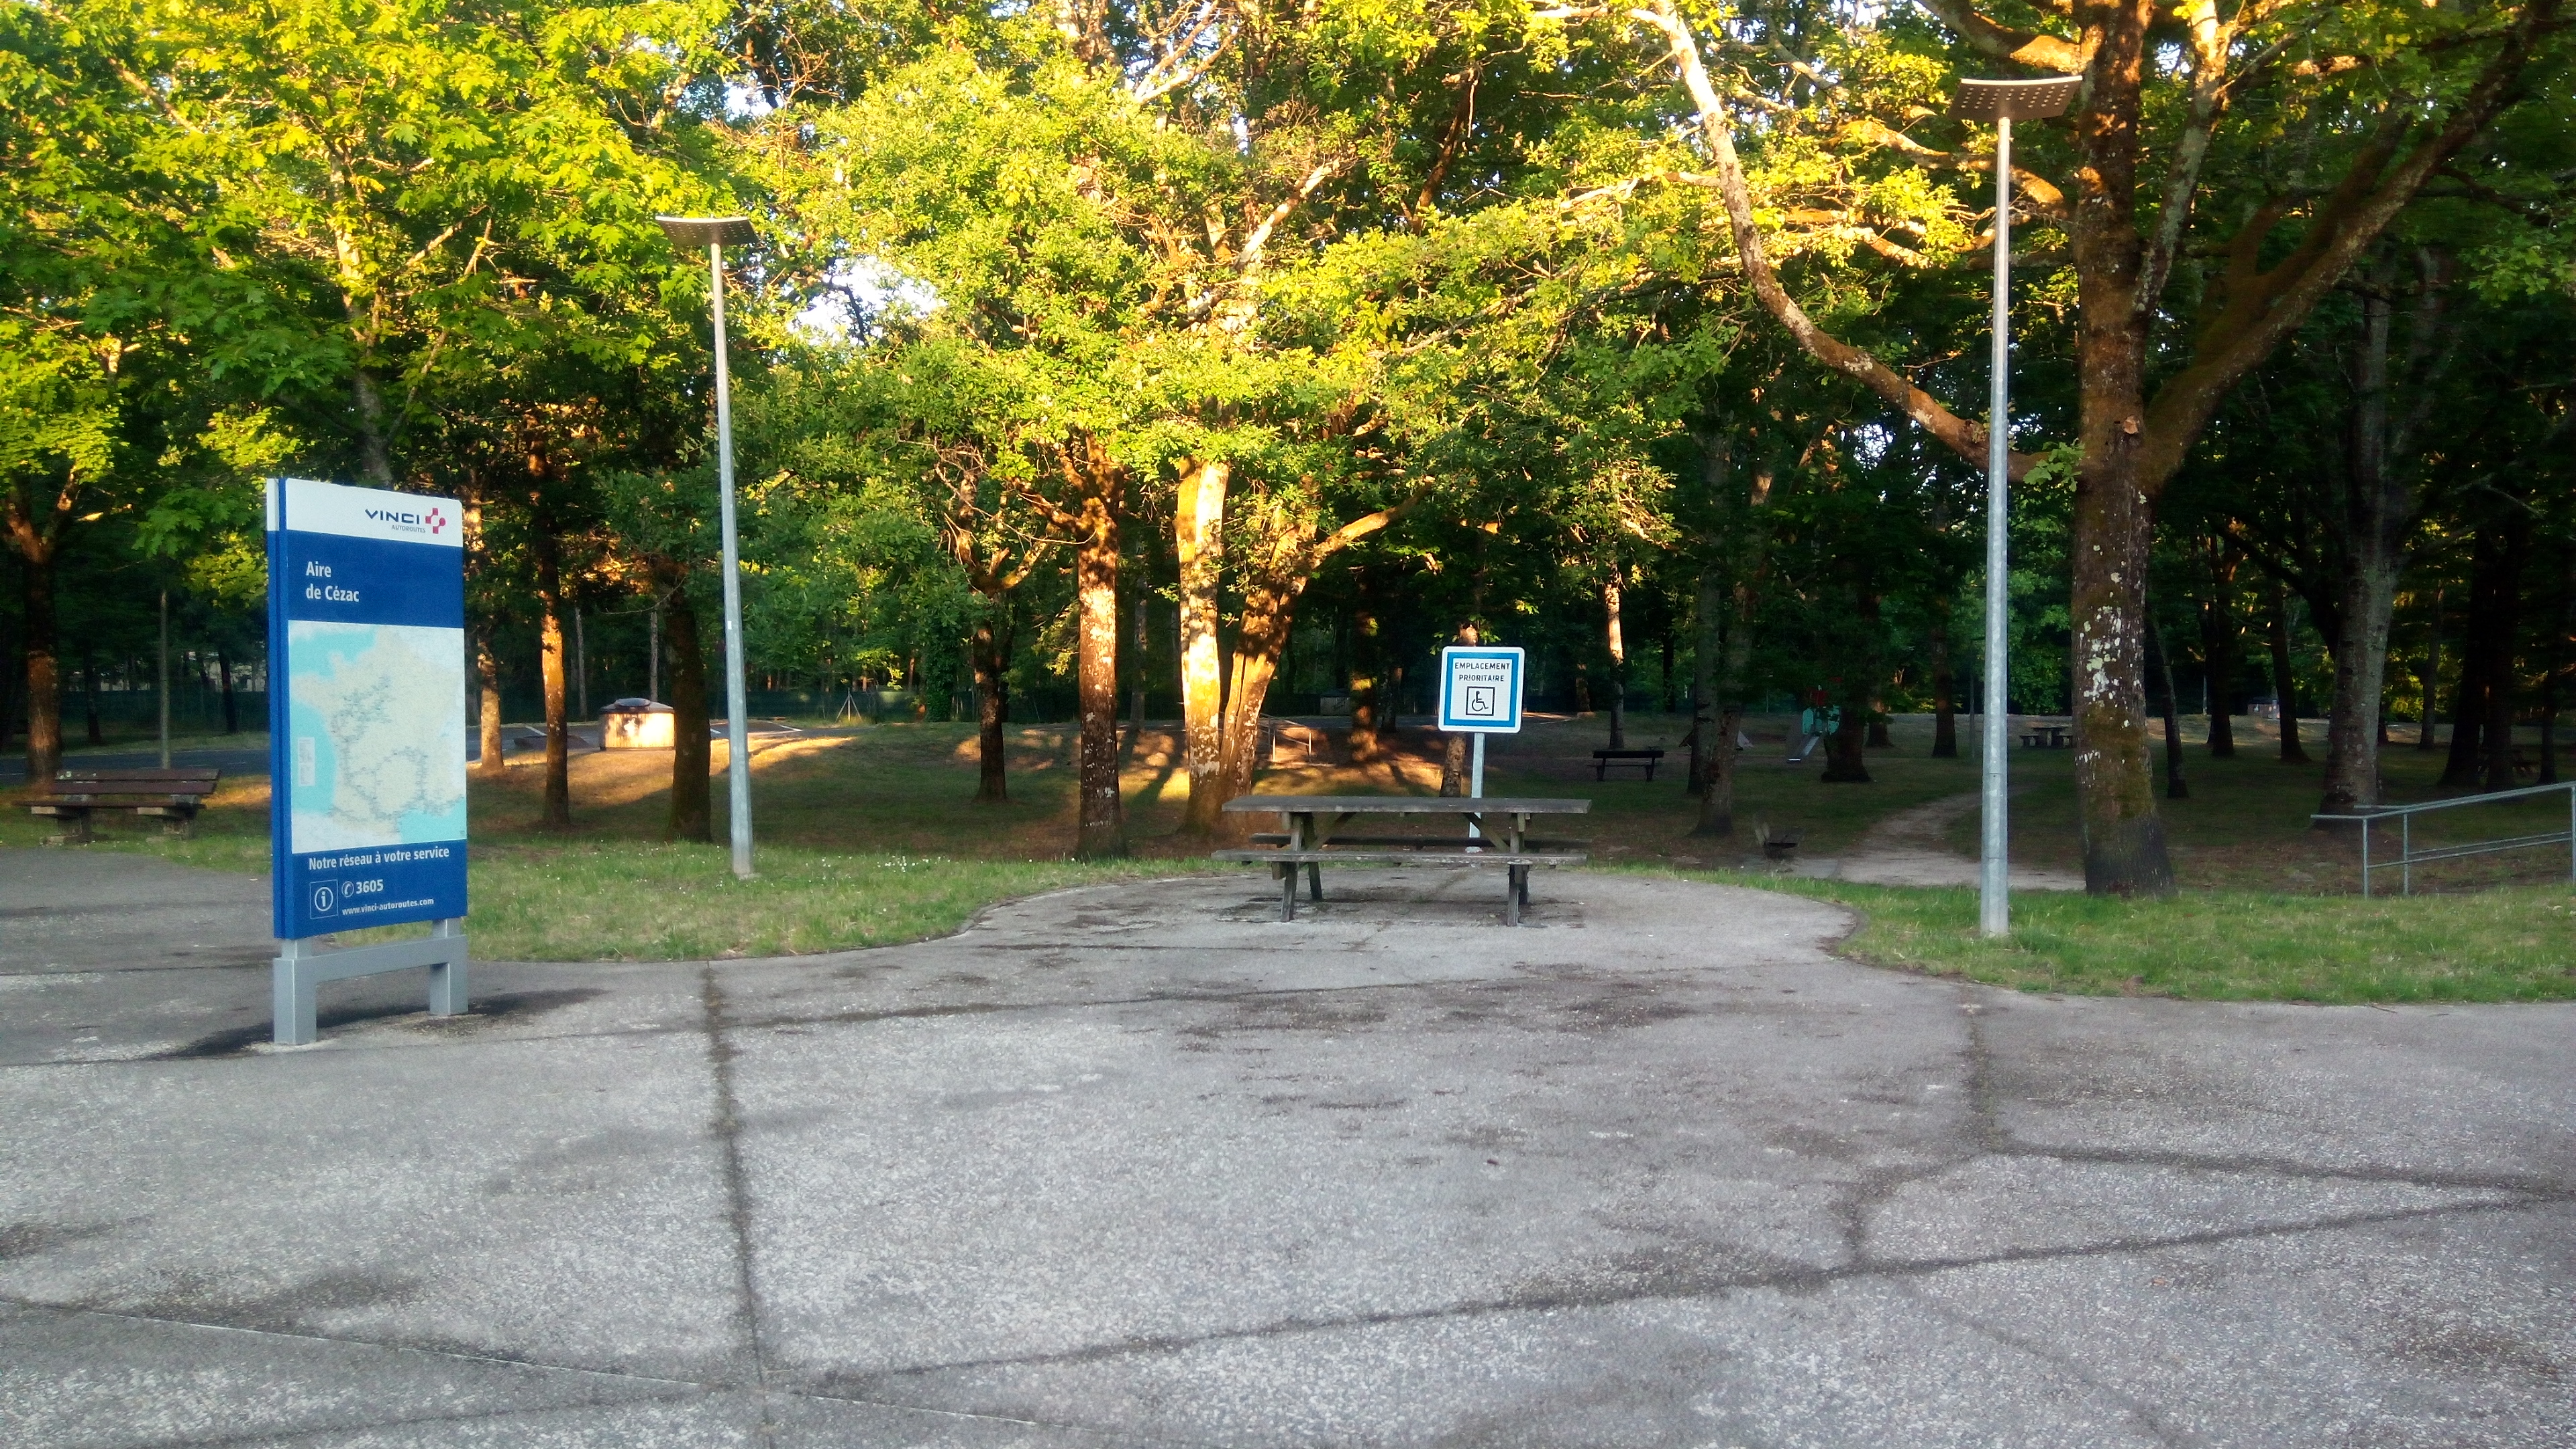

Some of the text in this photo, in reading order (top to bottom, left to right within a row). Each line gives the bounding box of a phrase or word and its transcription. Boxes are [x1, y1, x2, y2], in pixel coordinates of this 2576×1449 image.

[364, 508, 420, 525] VINCI
[391, 525, 426, 533] AUTOROUTES
[306, 561, 331, 577] Aire
[306, 583, 360, 602] de Cézac
[309, 845, 449, 871] Notre réseau à votre service
[356, 879, 384, 894] 3605
[341, 898, 434, 915] www.vinci-autoroutes.com
